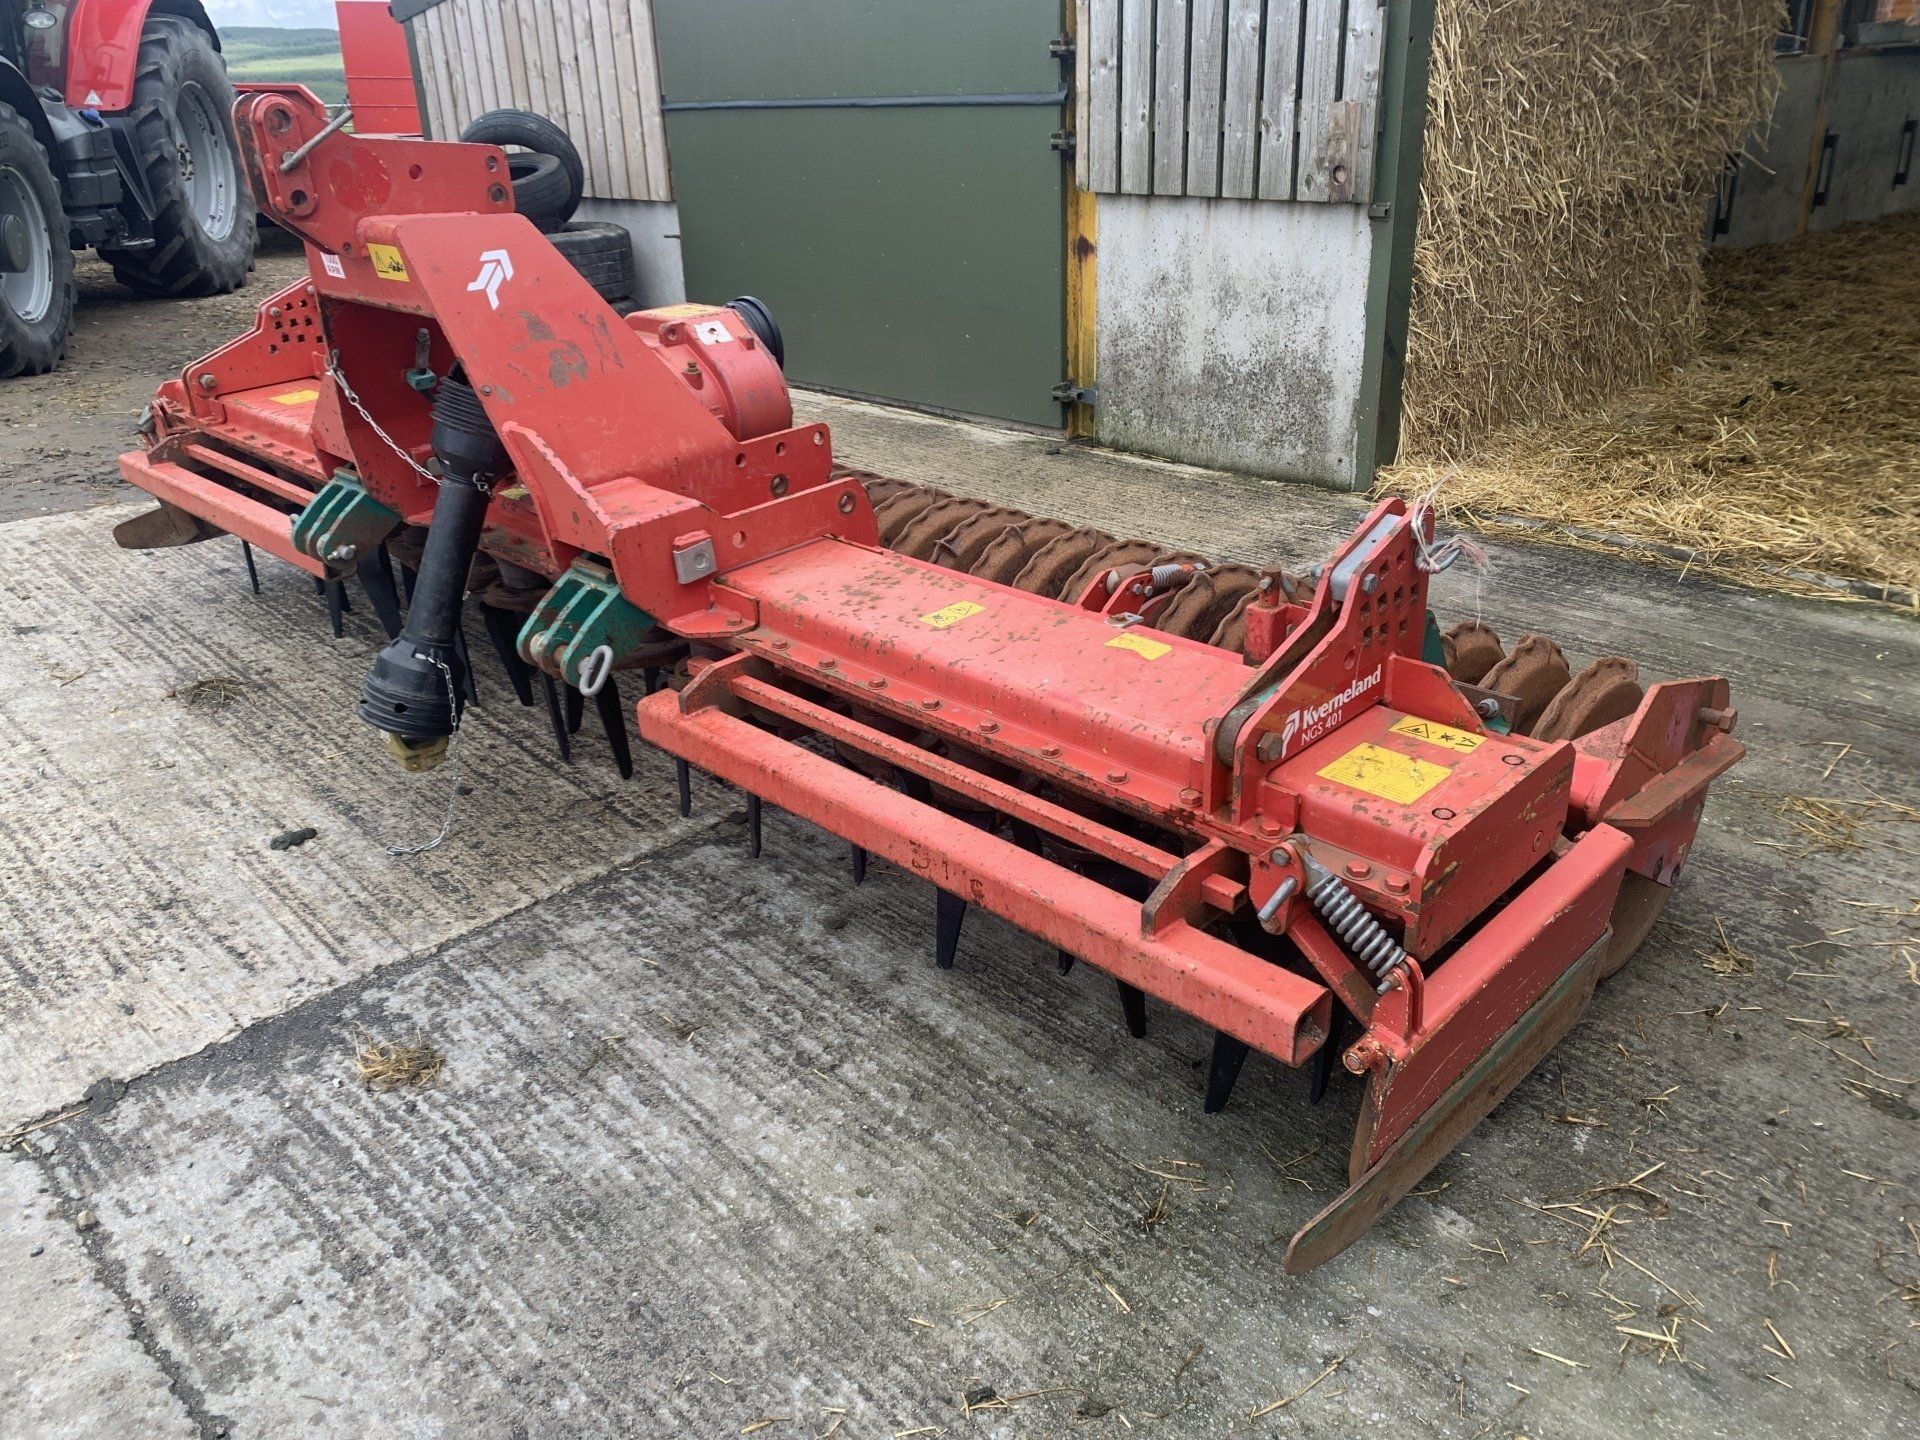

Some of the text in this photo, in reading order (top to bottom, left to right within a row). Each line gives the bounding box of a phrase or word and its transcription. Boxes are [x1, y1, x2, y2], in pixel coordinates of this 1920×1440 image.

[1303, 664, 1382, 729] Kverneland
[1301, 710, 1342, 745] NGS 401
